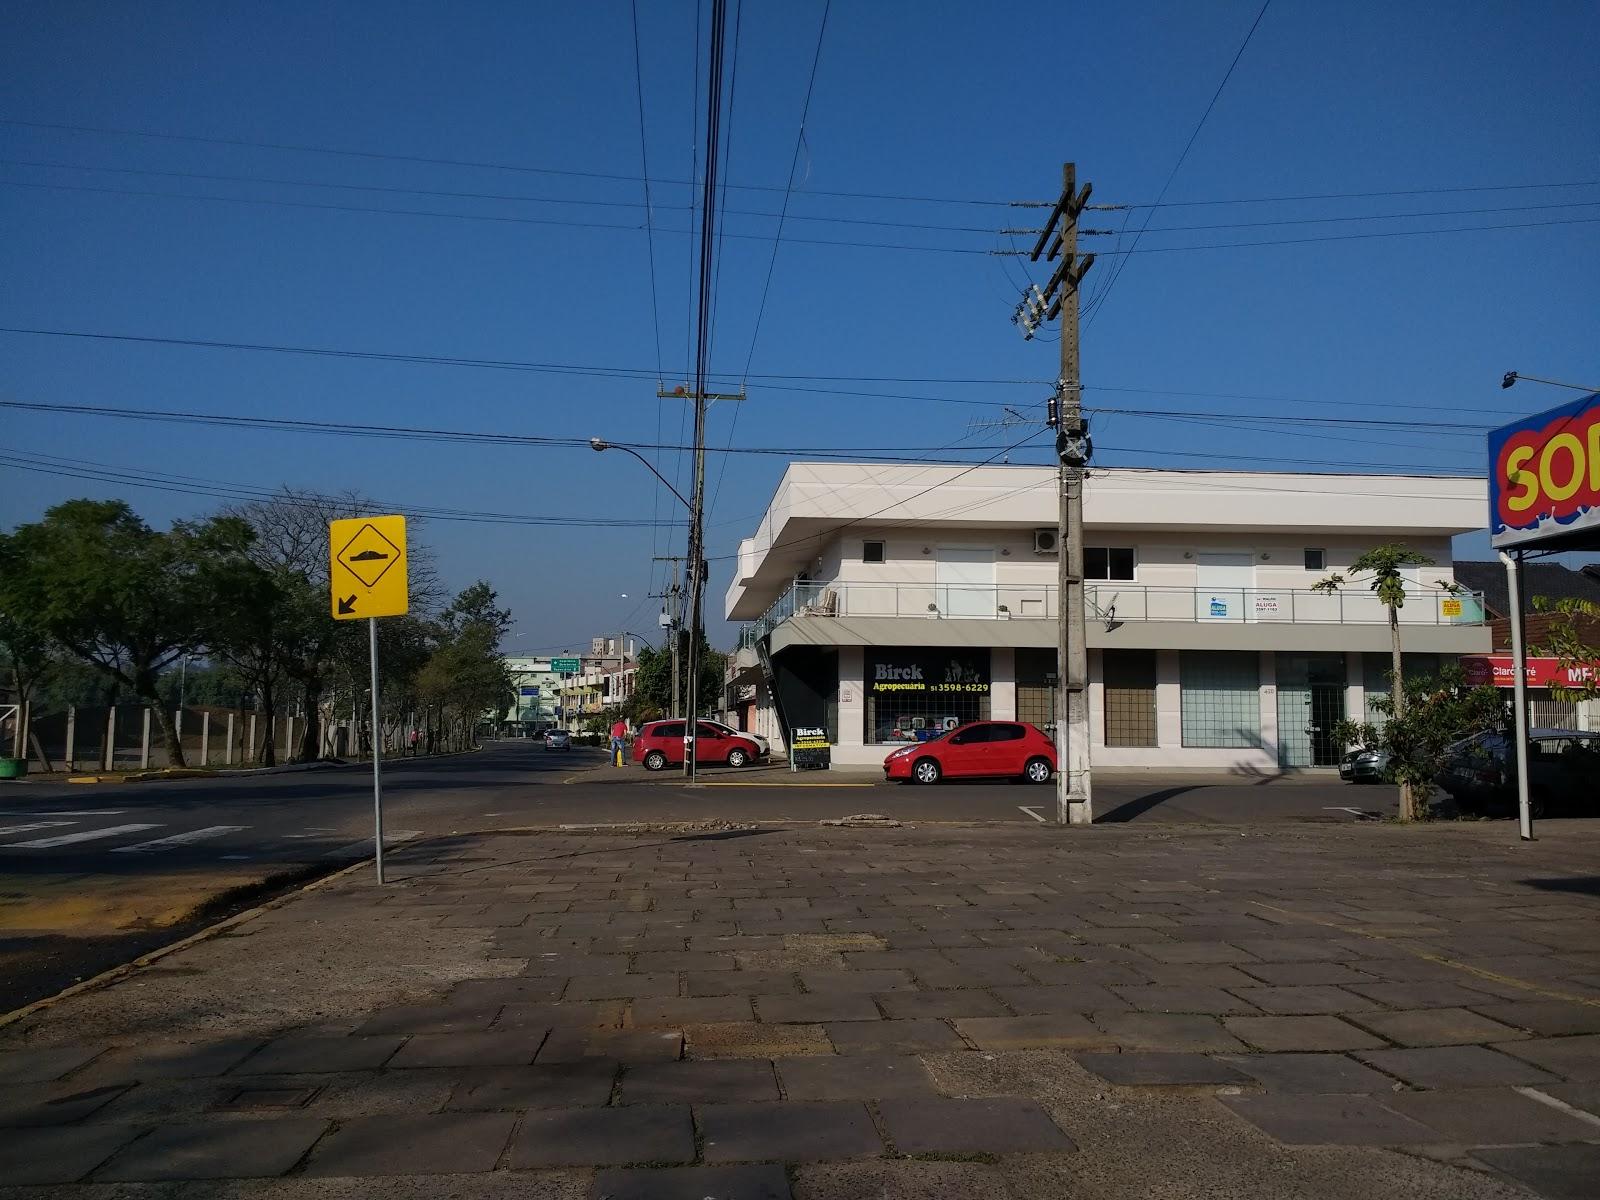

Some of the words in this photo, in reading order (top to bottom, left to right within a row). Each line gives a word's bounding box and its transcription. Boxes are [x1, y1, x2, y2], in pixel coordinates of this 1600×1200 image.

[875, 664, 923, 680] Birck
[873, 682, 926, 691] Agropecuária
[938, 684, 989, 692] 3598-6229
[796, 728, 825, 736] Birck
